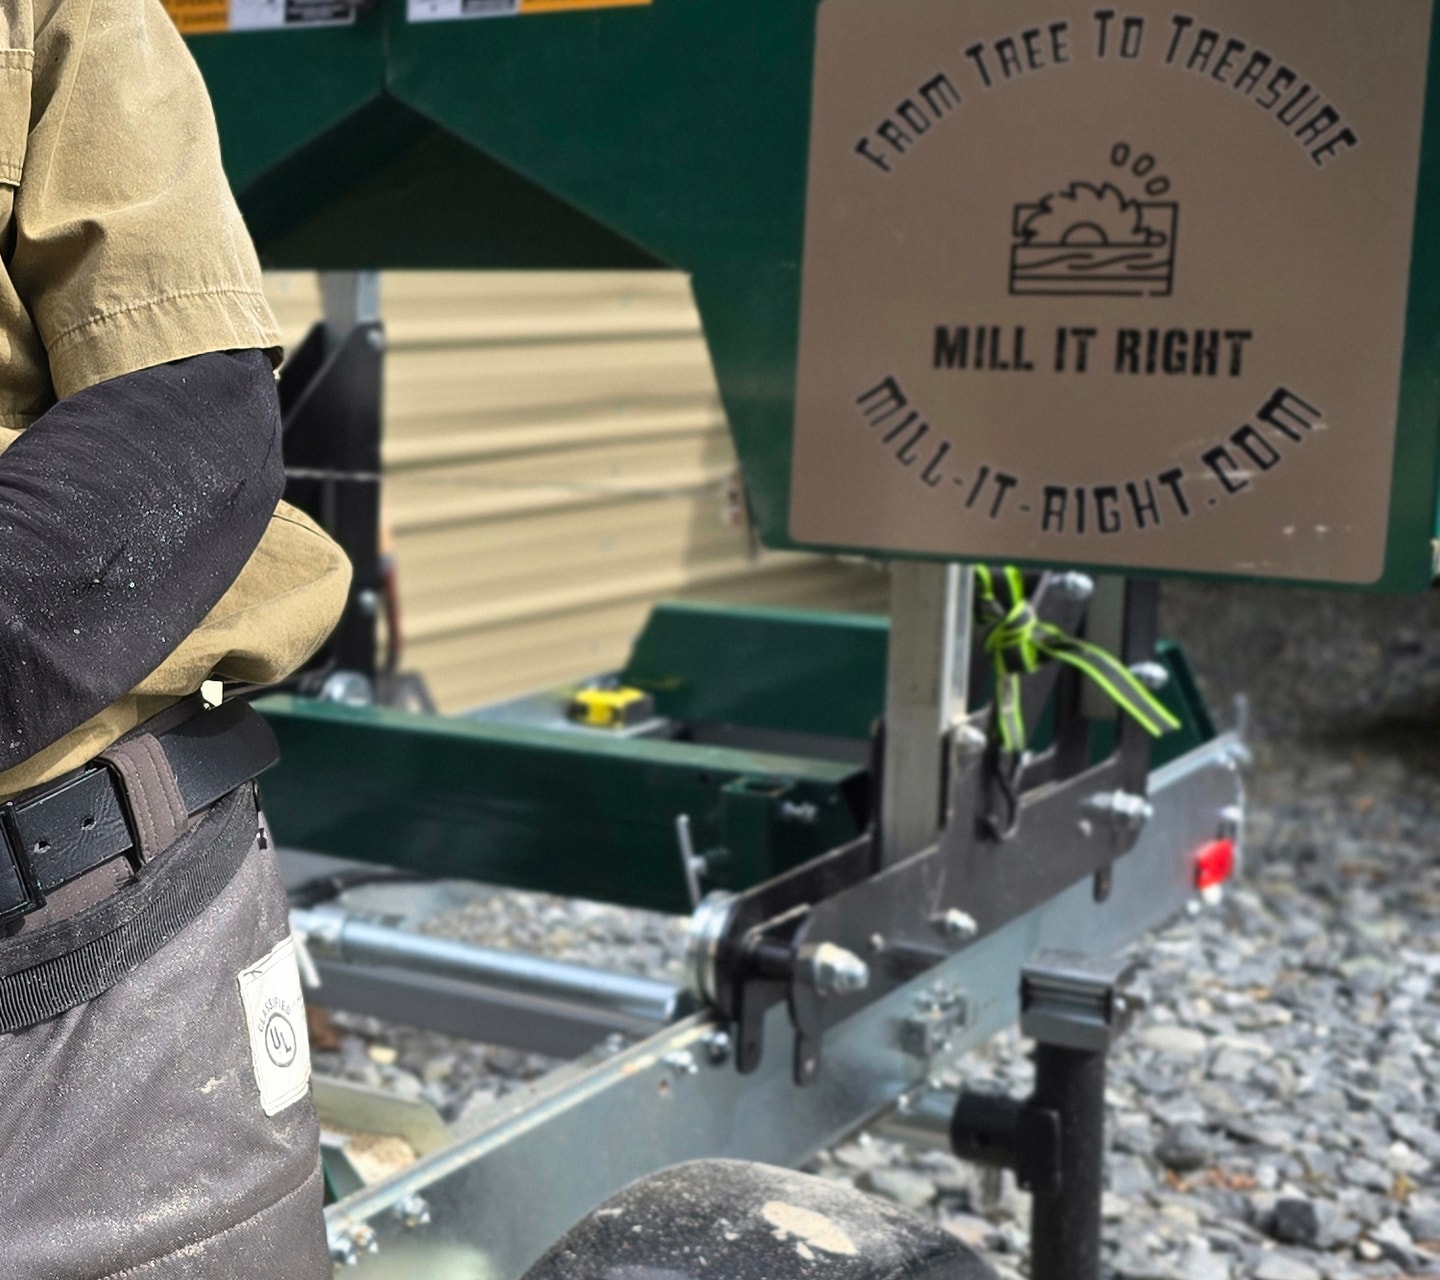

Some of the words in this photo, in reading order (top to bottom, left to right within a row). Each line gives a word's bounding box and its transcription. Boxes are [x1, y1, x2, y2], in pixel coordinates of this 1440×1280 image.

[854, 72, 963, 173] FROM
[966, 22, 1070, 89] TREE
[1093, 9, 1144, 61] TO
[1164, 14, 1358, 169] TREASURE
[932, 325, 1035, 374] MILL
[1053, 325, 1098, 375] IT
[1114, 328, 1253, 378] RIGHT
[855, 375, 1324, 536] MILL-IT-RIGHT.COM
[270, 1025, 292, 1054] UL
